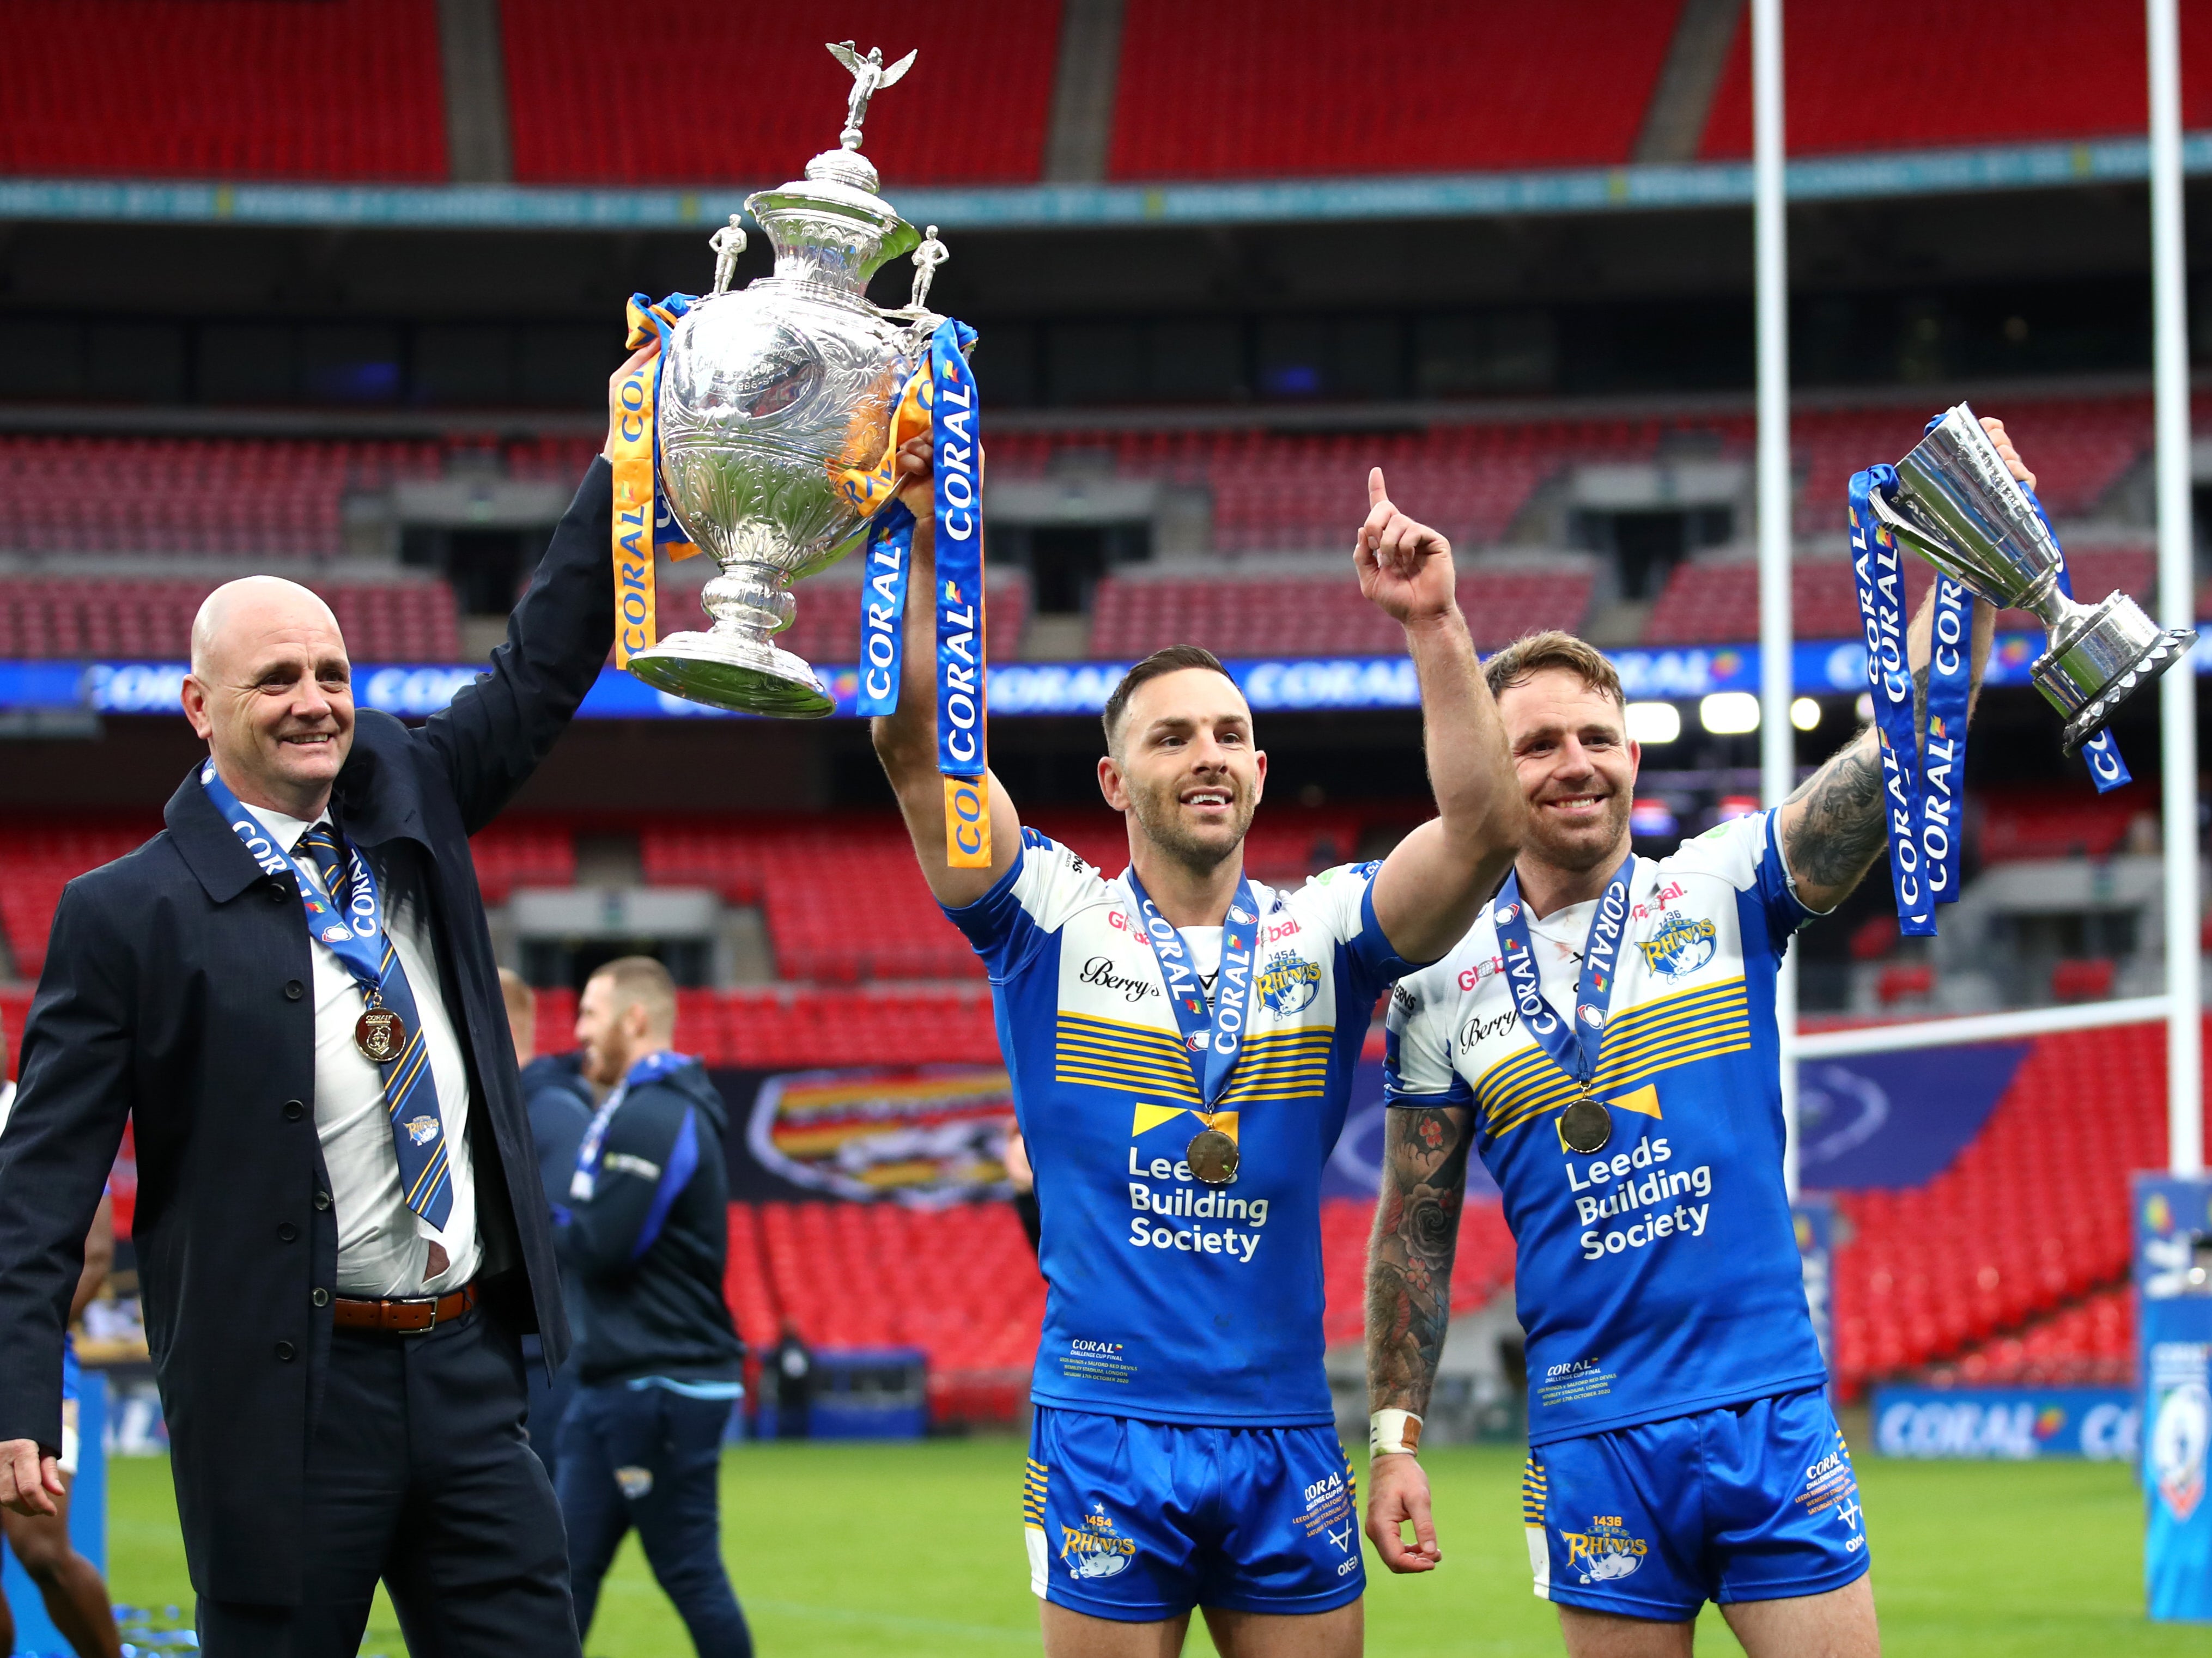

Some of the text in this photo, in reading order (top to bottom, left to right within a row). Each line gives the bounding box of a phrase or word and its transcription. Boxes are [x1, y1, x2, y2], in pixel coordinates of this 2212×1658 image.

[945, 384, 974, 541] CORAL
[622, 505, 646, 654] CORAL
[867, 546, 901, 699] CORAL
[1853, 528, 1879, 685] CORAL
[1936, 579, 1962, 676] COR
[946, 605, 975, 761] CORAL
[1883, 748, 1919, 906] CORAL
[1924, 739, 1954, 892] CORAL
[348, 848, 376, 937] CORAL
[1143, 899, 1189, 1001] CORAL
[1588, 882, 1625, 972] CORAL
[1268, 949, 1296, 961] 1454
[1080, 956, 1161, 1002] Berry's
[1215, 950, 1250, 1054] CORAL
[1508, 946, 1557, 1034] CORAL
[1129, 1147, 1238, 1184] Lee
[1565, 1136, 1672, 1192] Leeds
[1129, 1182, 1268, 1227] Building
[1575, 1166, 1712, 1227] Building
[1129, 1217, 1261, 1263] Society
[1581, 1203, 1710, 1260] Society
[1072, 1339, 1114, 1354] CORAL
[1547, 1360, 1591, 1376] CORAL
[1567, 1379, 1589, 1388] SALFORD
[1599, 1373, 1617, 1381] DEVILS
[1585, 1368, 1601, 1376] FINAL
[1585, 1382, 1609, 1390] LONDON
[1573, 1391, 1597, 1400] OCTOBER
[1305, 1471, 1341, 1501] CORAL
[1806, 1452, 1841, 1479] CORAL
[1326, 1490, 1337, 1500] CUP
[1795, 1492, 1812, 1504] LEEDS
[1085, 1515, 1113, 1527] 1454
[1293, 1514, 1310, 1524] LEEDS
[1593, 1515, 1622, 1527] 1436
